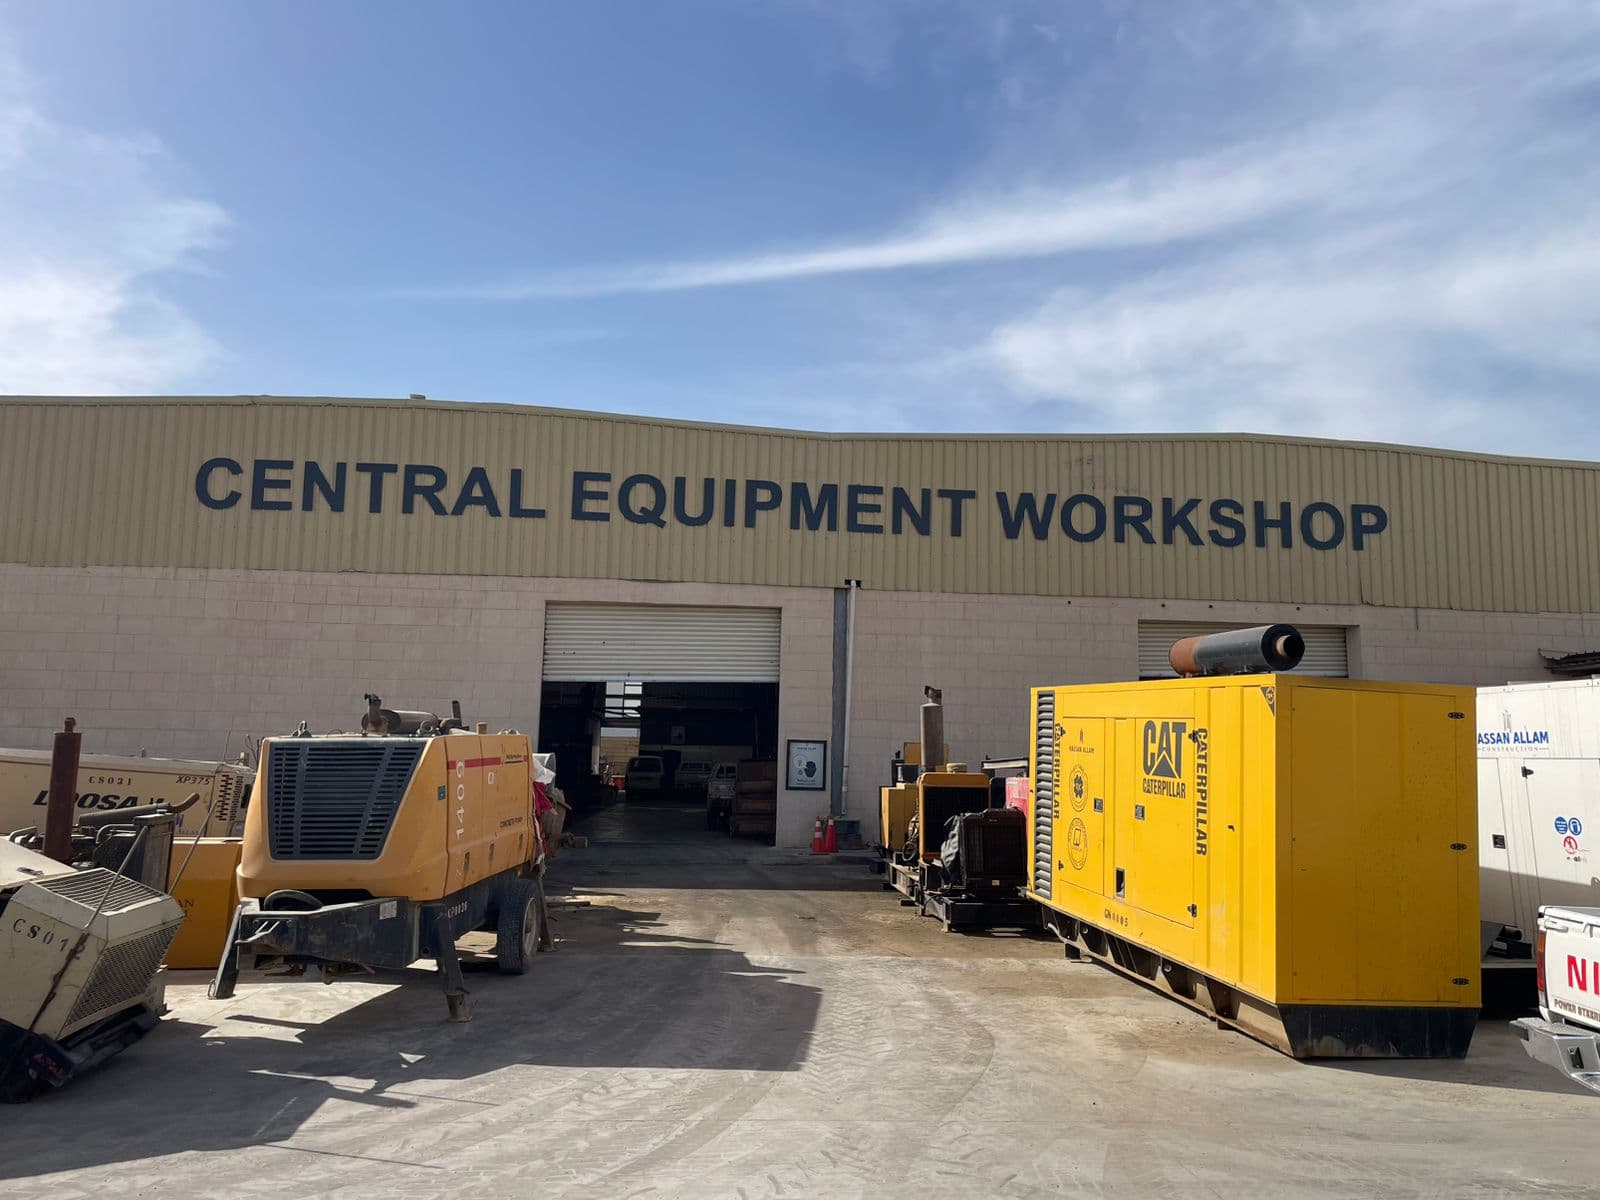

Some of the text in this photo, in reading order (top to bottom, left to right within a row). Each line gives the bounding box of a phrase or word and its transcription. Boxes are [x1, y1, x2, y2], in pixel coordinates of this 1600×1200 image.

[195, 457, 1388, 551] CENTRAL EQUIPMENT WORKSHOP
[1513, 731, 1549, 744] ALLAM
[1143, 720, 1186, 778] CAT
[176, 775, 211, 785] XP375
[1143, 778, 1186, 799] CATERPILLAR
[1196, 728, 1208, 856] CATERPILLAR
[1554, 998, 1577, 1014] POWER
